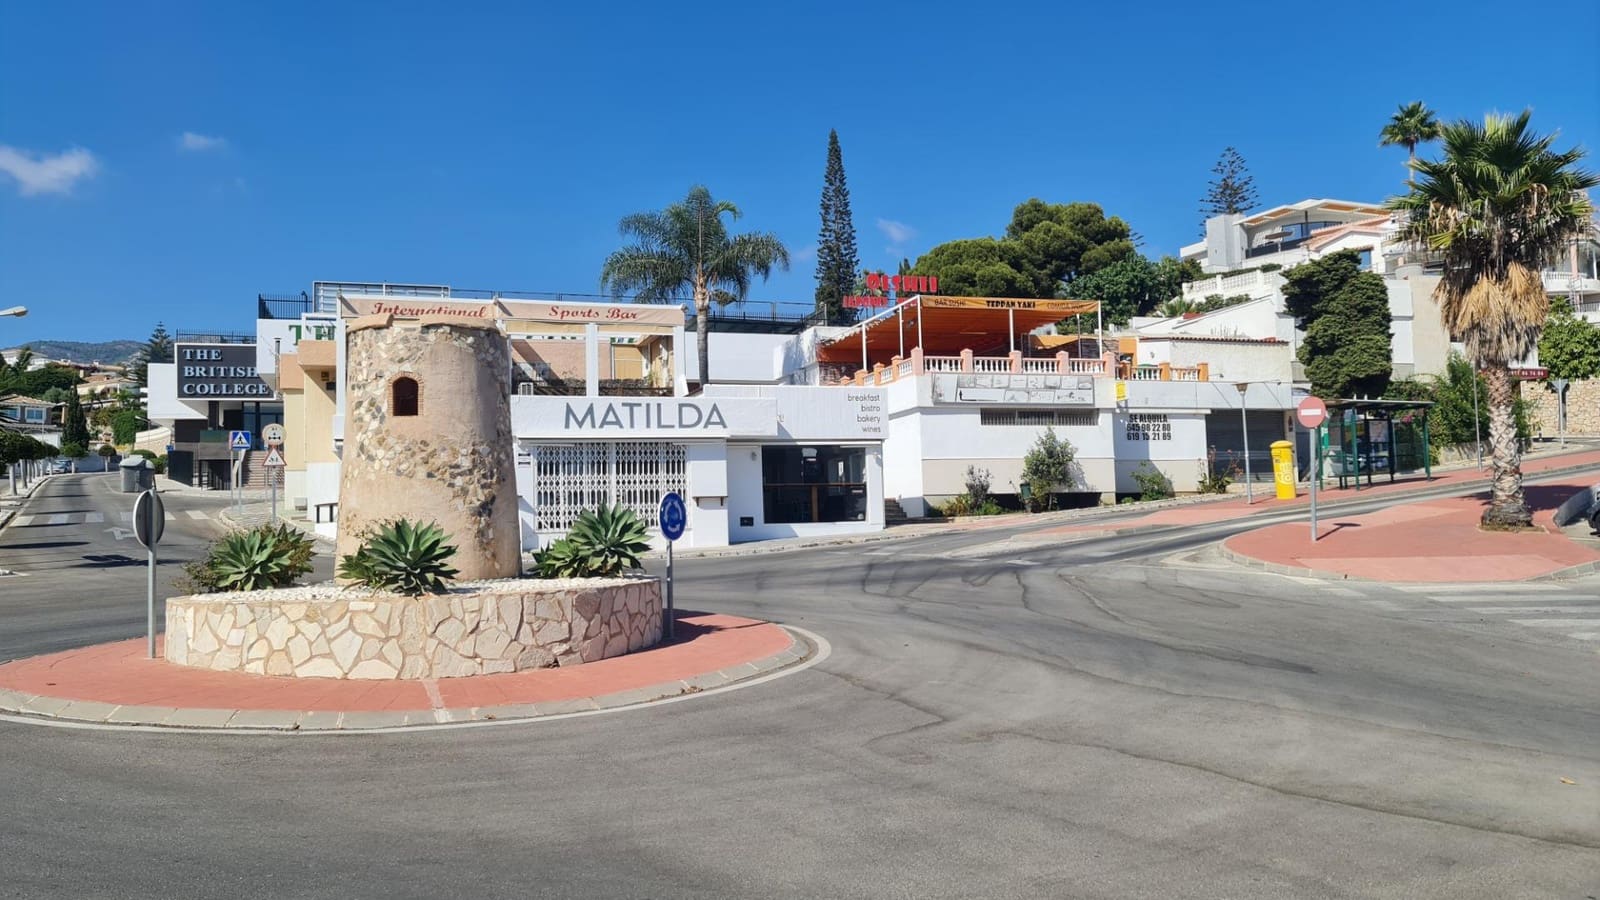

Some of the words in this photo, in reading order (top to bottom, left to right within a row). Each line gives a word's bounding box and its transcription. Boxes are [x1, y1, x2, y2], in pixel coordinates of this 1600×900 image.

[866, 272, 938, 293] OISHII
[371, 302, 487, 318] International
[549, 301, 600, 319] Sports
[606, 307, 639, 319] Bar
[183, 349, 222, 360] THE
[184, 366, 259, 378] BRITISH
[183, 383, 270, 396] COLLEGE
[847, 393, 881, 402] breakfast
[861, 404, 881, 412] bistro
[564, 402, 728, 429] MATILDA
[857, 414, 881, 423] bakery
[1129, 414, 1138, 423] SE
[1139, 414, 1168, 423] ALQUILA
[1152, 423, 1161, 432] 22
[1126, 432, 1140, 441] 619
[1152, 432, 1160, 441] 21
